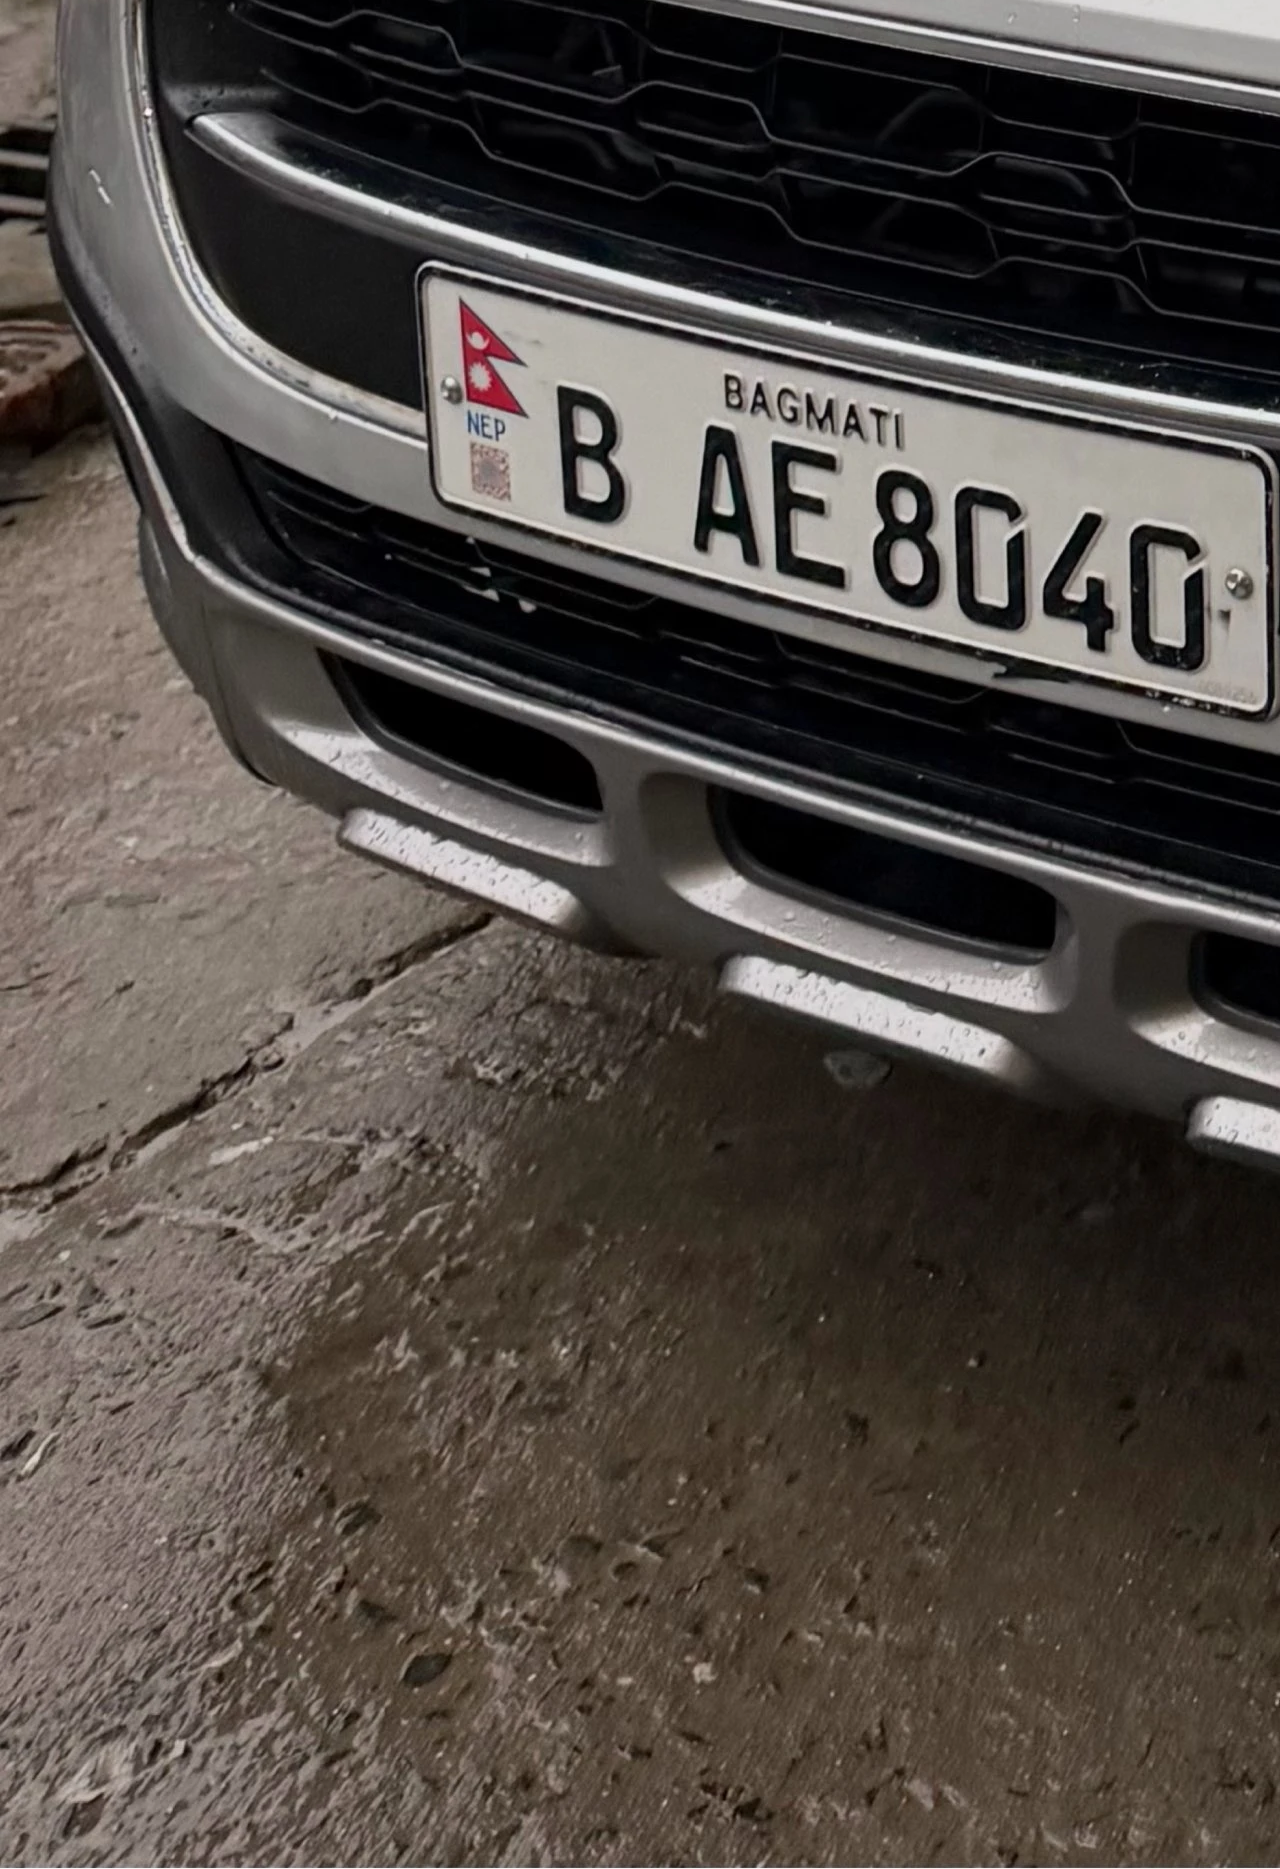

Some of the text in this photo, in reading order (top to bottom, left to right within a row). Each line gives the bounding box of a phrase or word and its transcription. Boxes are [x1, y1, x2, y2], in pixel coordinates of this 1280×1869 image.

[467, 410, 506, 442] NEP
[724, 373, 905, 449] BAGMATI
[557, 385, 626, 524] B
